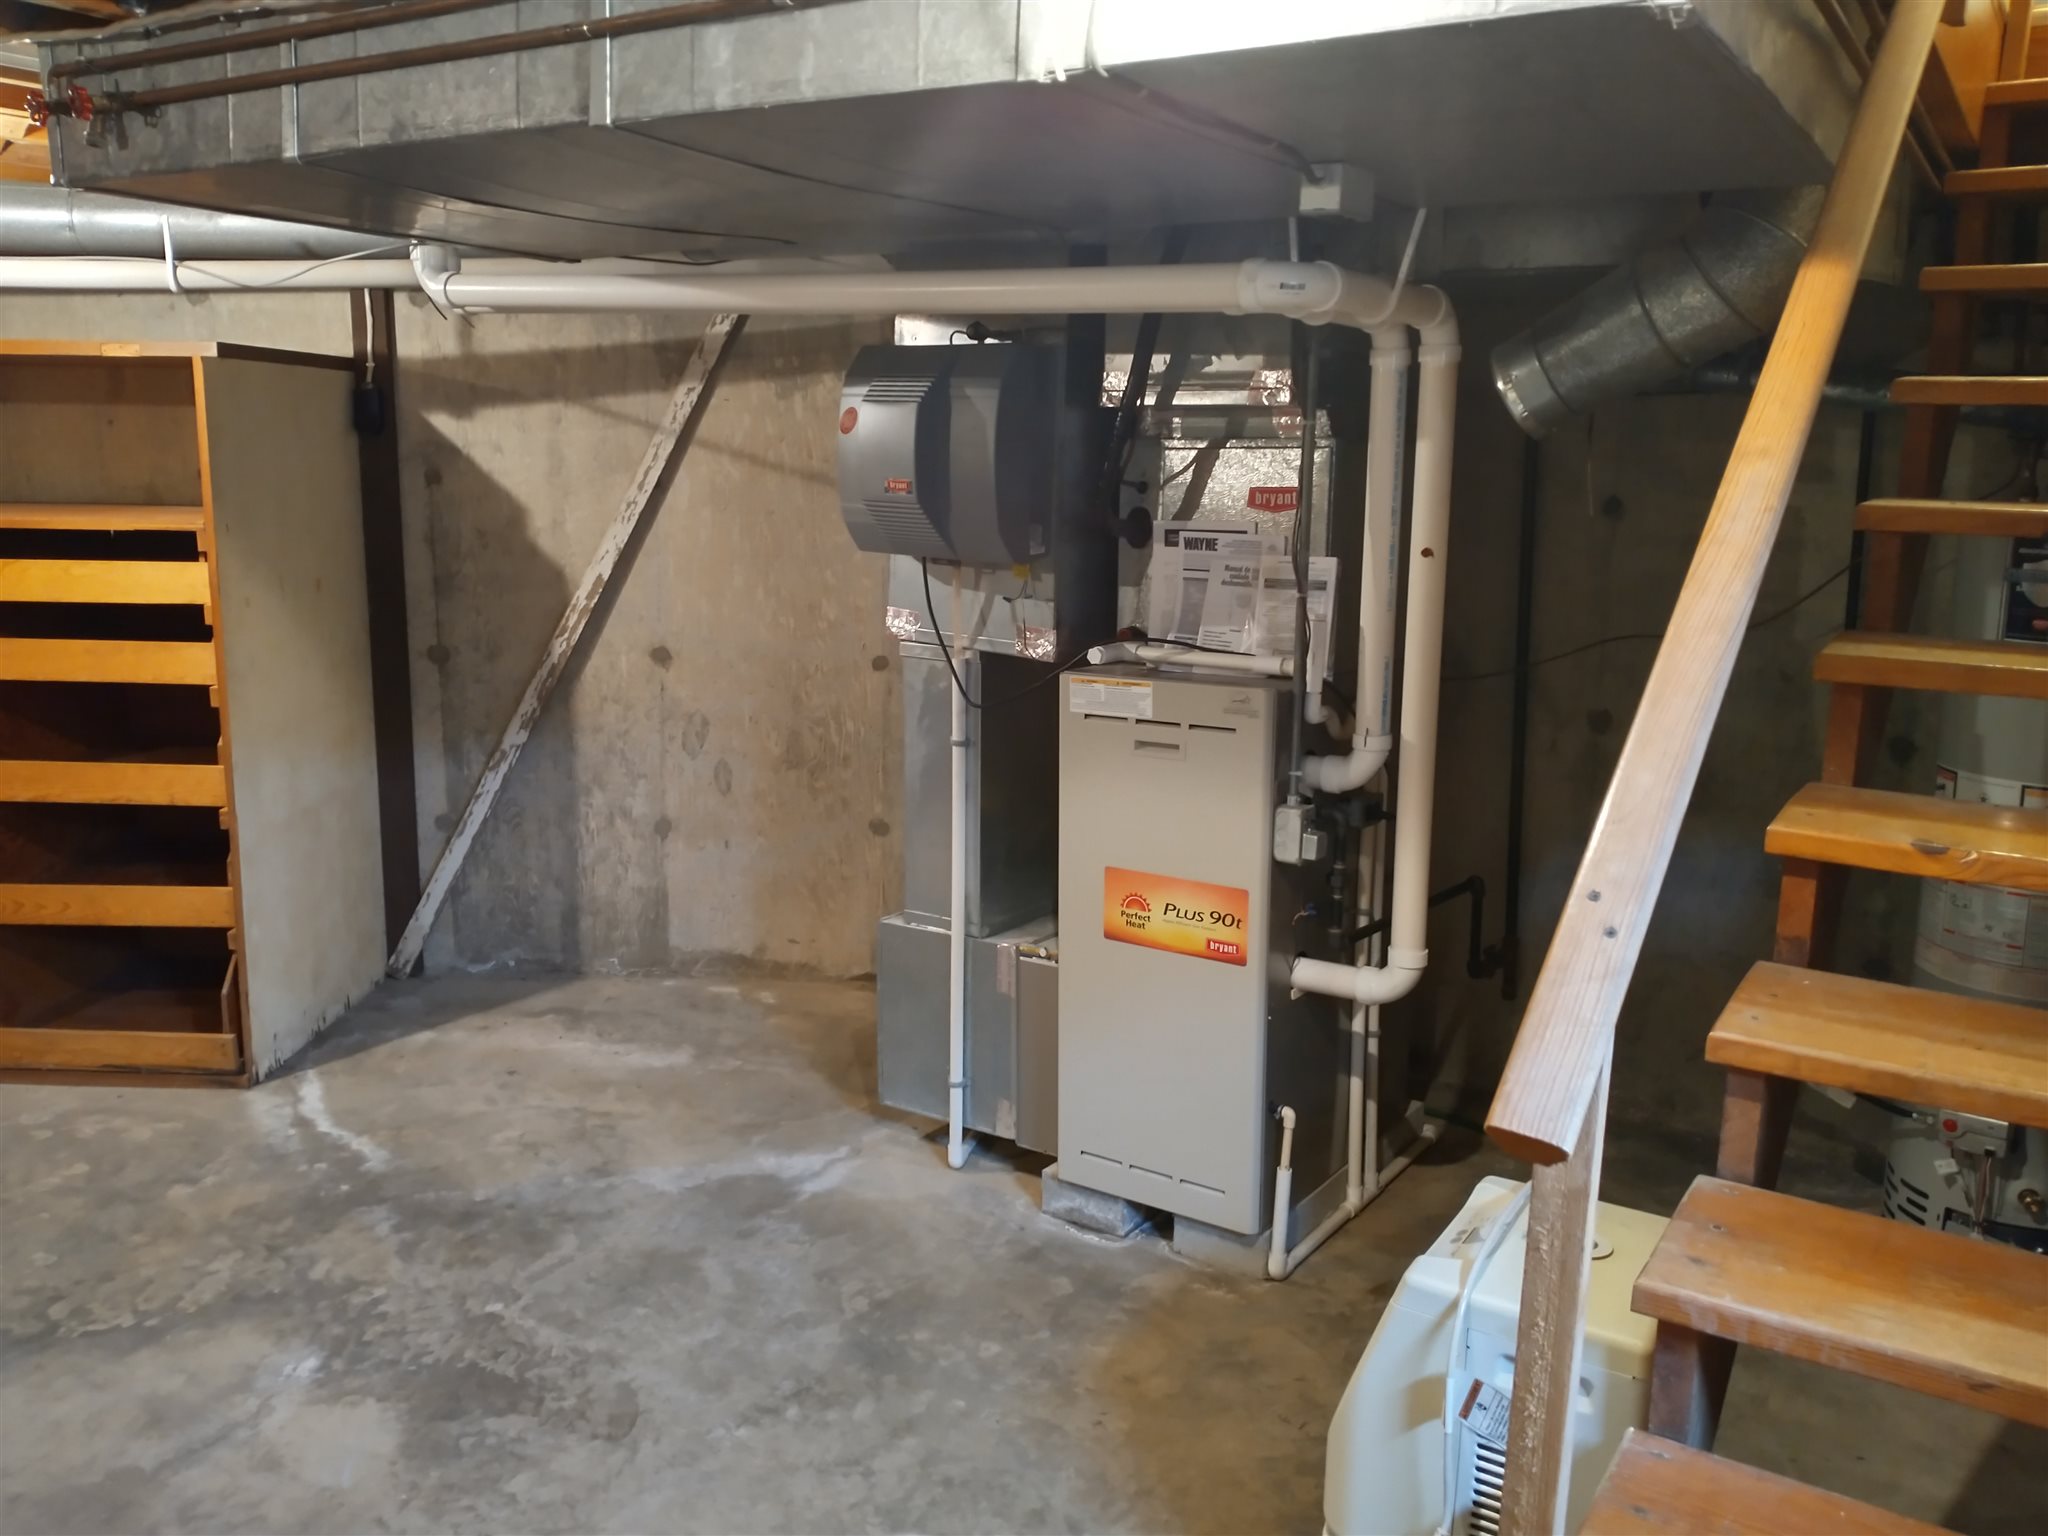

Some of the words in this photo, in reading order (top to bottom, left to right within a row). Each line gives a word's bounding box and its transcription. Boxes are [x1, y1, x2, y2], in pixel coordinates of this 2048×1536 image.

[1255, 491, 1297, 507] bryant
[1183, 536, 1219, 551] WAYNE
[1120, 910, 1151, 923] Perfect
[1126, 920, 1146, 930] Heat
[1210, 940, 1237, 954] bryant
